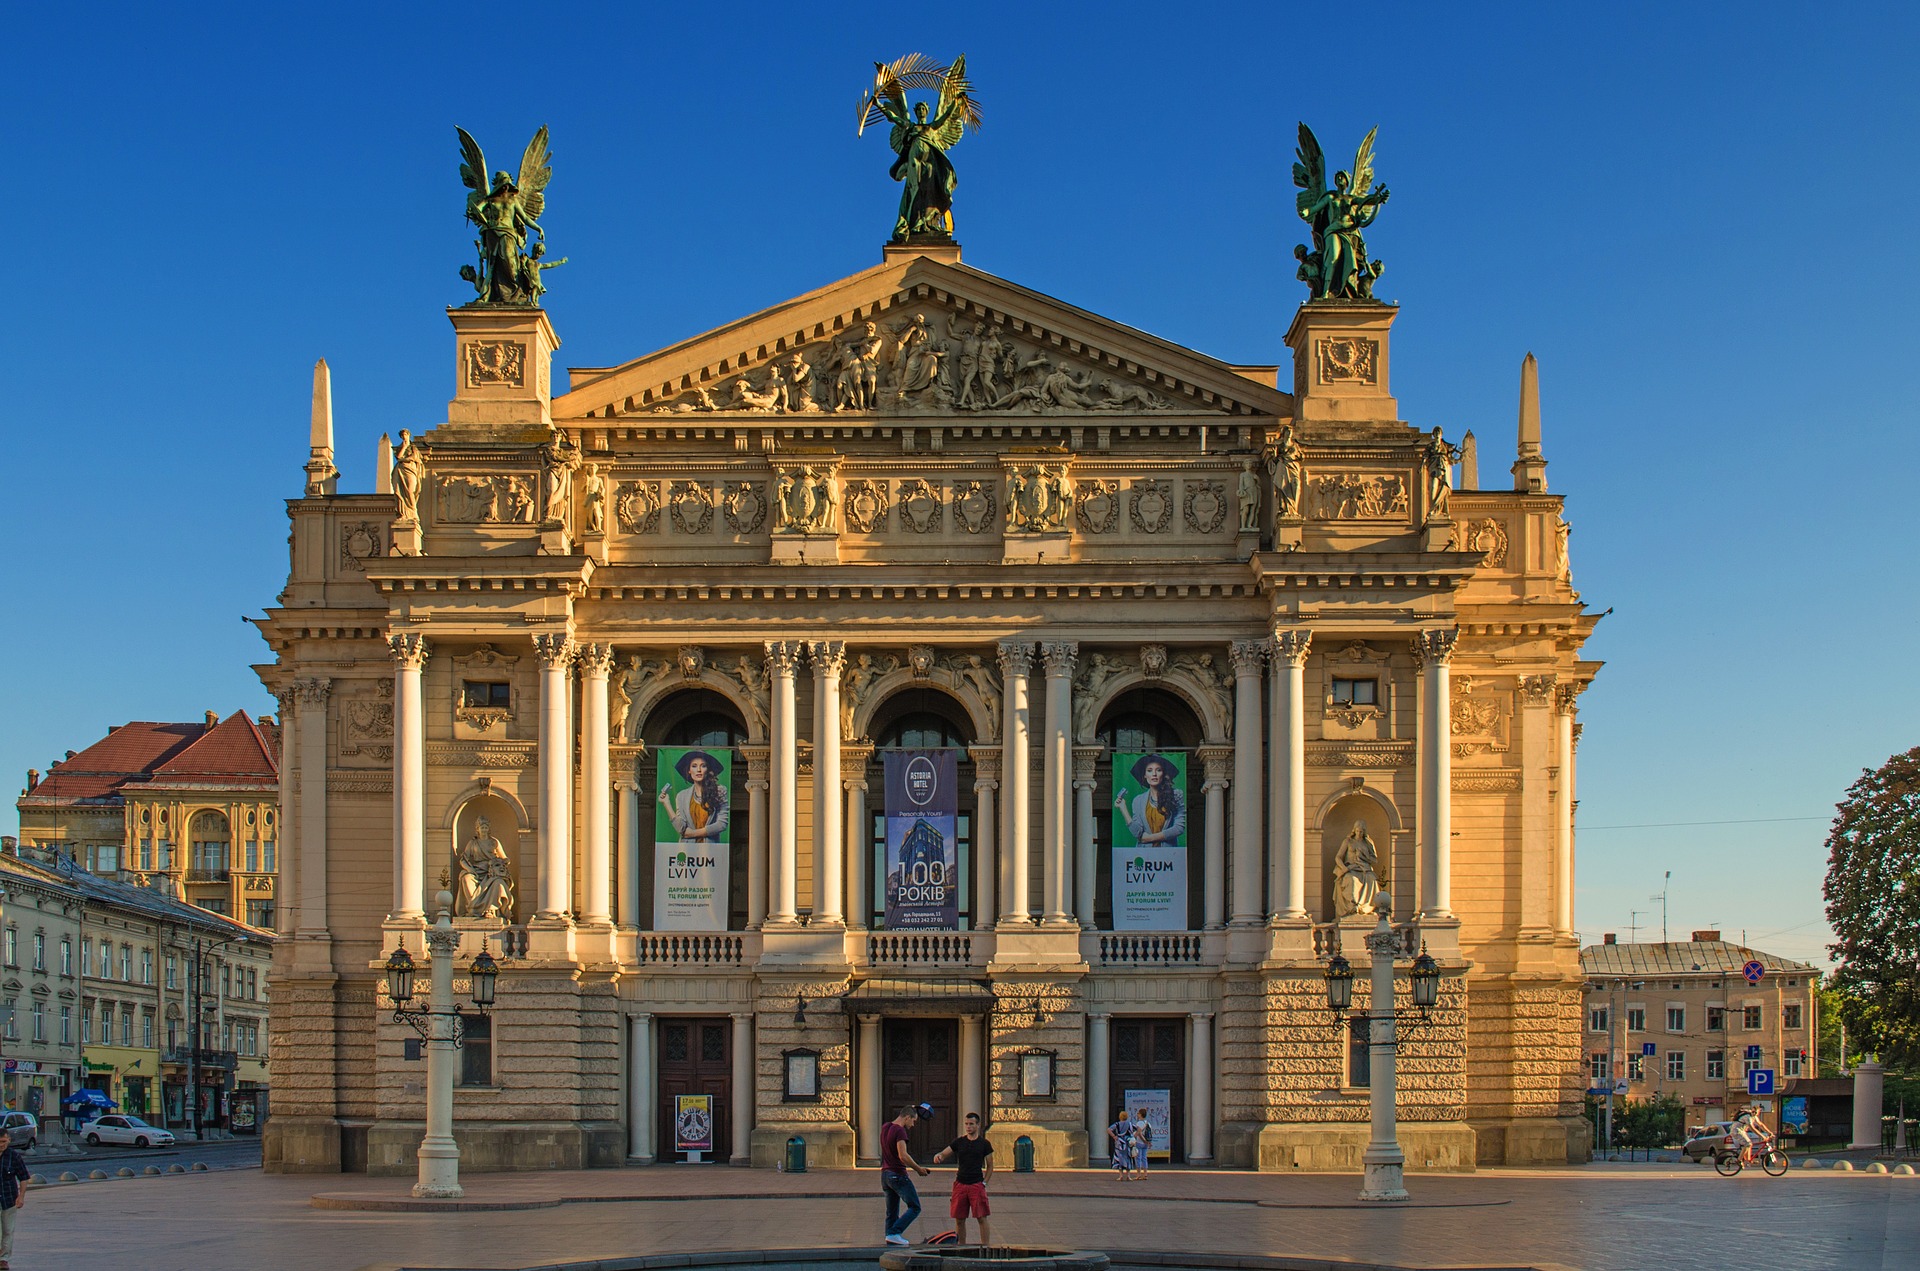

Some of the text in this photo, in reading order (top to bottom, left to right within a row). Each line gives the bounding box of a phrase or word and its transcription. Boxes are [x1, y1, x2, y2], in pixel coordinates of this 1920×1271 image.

[669, 852, 715, 867] FORUM
[1126, 857, 1173, 871] FORUM
[668, 868, 698, 878] LVIV
[899, 861, 944, 885] 100
[1126, 873, 1155, 883] LVIV
[899, 887, 944, 901] РОКІВ
[1755, 1073, 1767, 1091] P
[679, 1107, 708, 1122] МАШИНА
[679, 1125, 708, 1139] ВРЕМЕНИ
